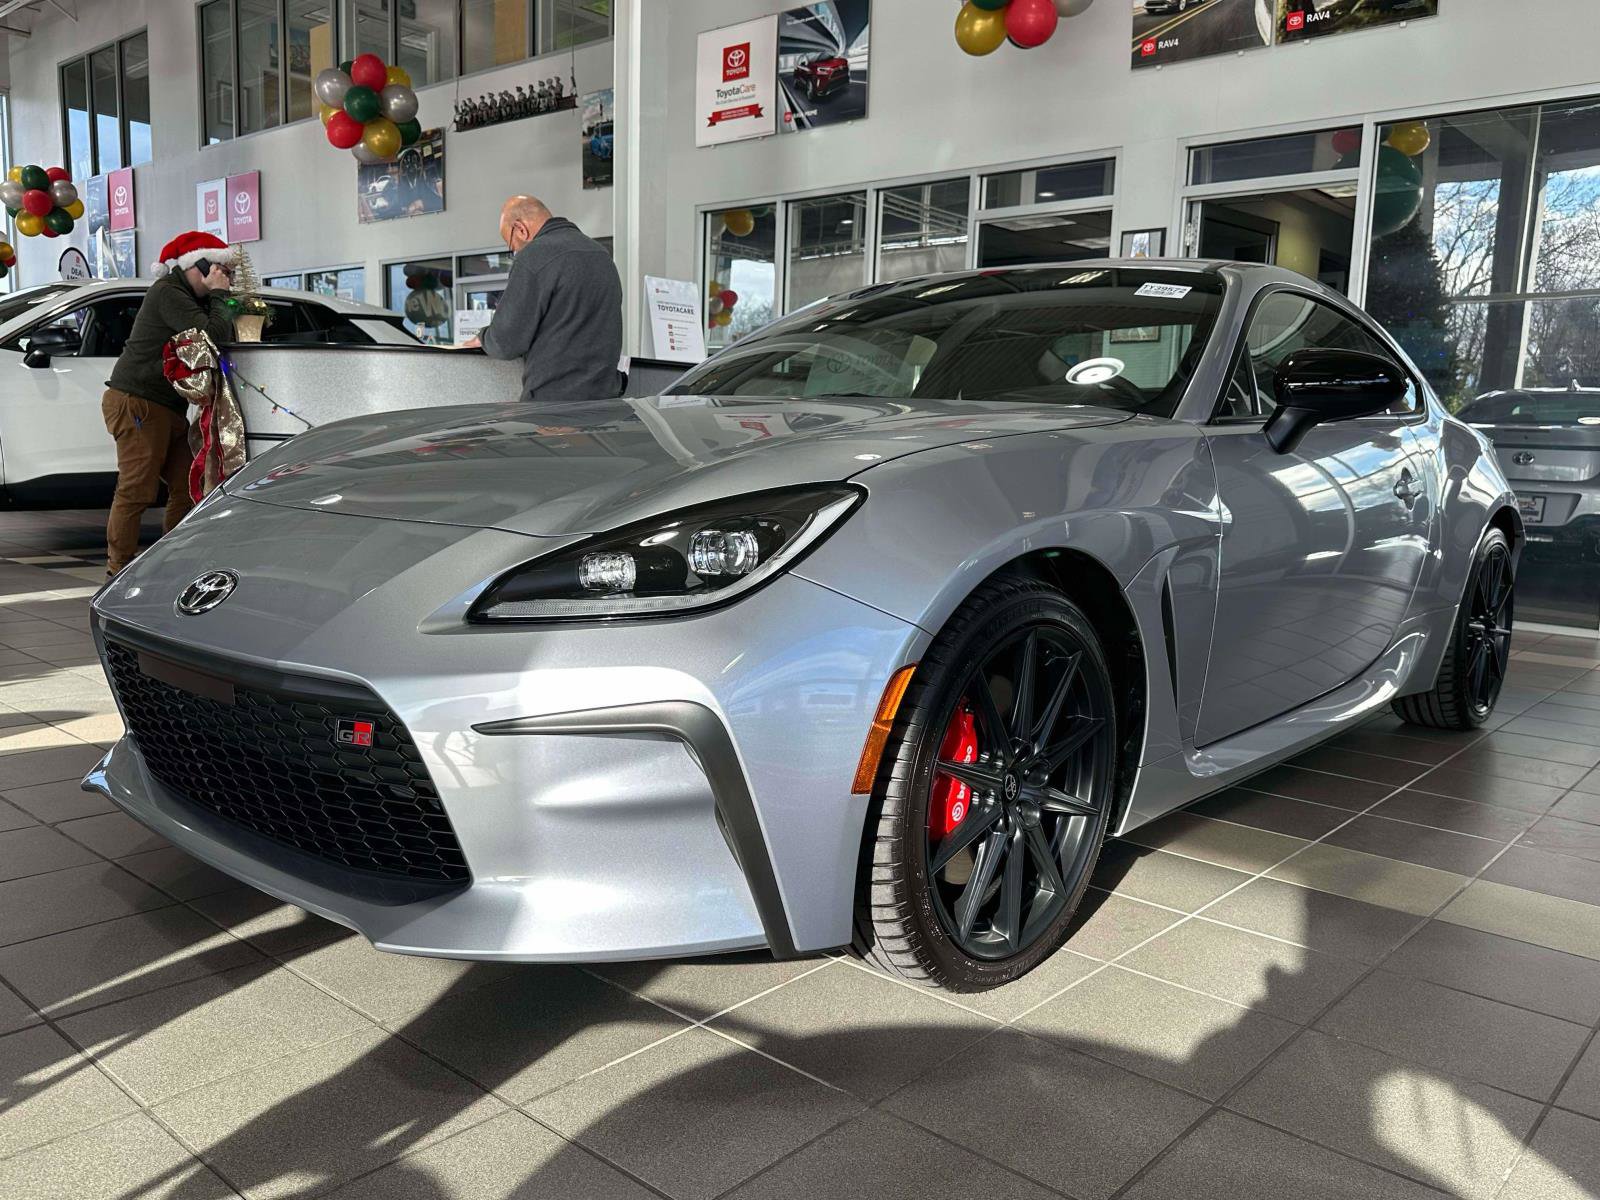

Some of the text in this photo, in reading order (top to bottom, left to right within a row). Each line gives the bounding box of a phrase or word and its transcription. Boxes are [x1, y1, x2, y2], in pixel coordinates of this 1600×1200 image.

[1306, 11, 1330, 23] RAV4
[1158, 38, 1180, 50] RAV4
[726, 67, 747, 77] TOYOTA
[716, 84, 756, 99] ToyotaCare
[114, 208, 129, 216] TOYOTA
[234, 216, 253, 225] TOYOTA
[657, 304, 695, 315] TOYOTACARE
[339, 729, 371, 745] GR
